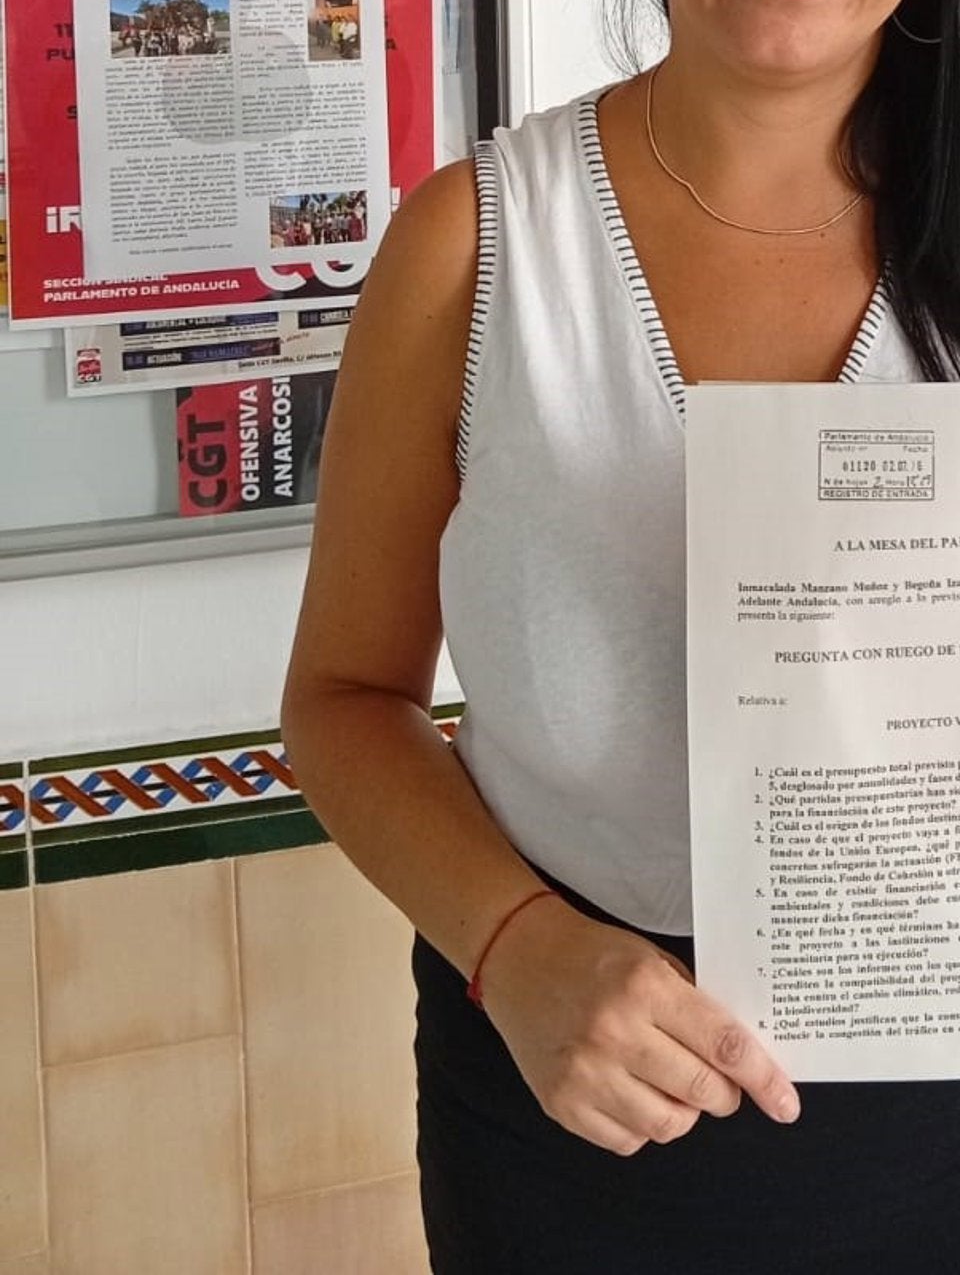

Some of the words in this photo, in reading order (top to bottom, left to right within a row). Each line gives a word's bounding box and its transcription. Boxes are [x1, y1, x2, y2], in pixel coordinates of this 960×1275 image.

[43, 286, 137, 303] PARLAMENTO
[140, 286, 159, 295] DE
[239, 384, 260, 501] OFENSIVA
[187, 414, 228, 508] CGT
[834, 540, 844, 552] A
[848, 540, 865, 552] LA
[870, 539, 906, 551] MESA
[910, 538, 938, 549] DEL
[801, 582, 848, 593] Manzano
[853, 580, 888, 591] Muñoz
[904, 579, 941, 592] Begoña
[738, 596, 782, 606] Adelante
[846, 597, 863, 606] con
[867, 594, 901, 607] arreglo
[774, 650, 849, 663] PREGUNTA
[852, 648, 881, 661] CON
[885, 645, 934, 659] RUEGO
[937, 644, 956, 656] DE
[738, 695, 777, 706] Relativa
[886, 716, 951, 730] PROYECTO
[755, 767, 763, 777] 1.
[769, 766, 798, 779] ¿Cuál
[801, 768, 812, 777] es
[814, 767, 823, 776] el
[826, 764, 887, 779] presupuesto
[889, 762, 912, 773] total
[914, 760, 955, 773] previsto
